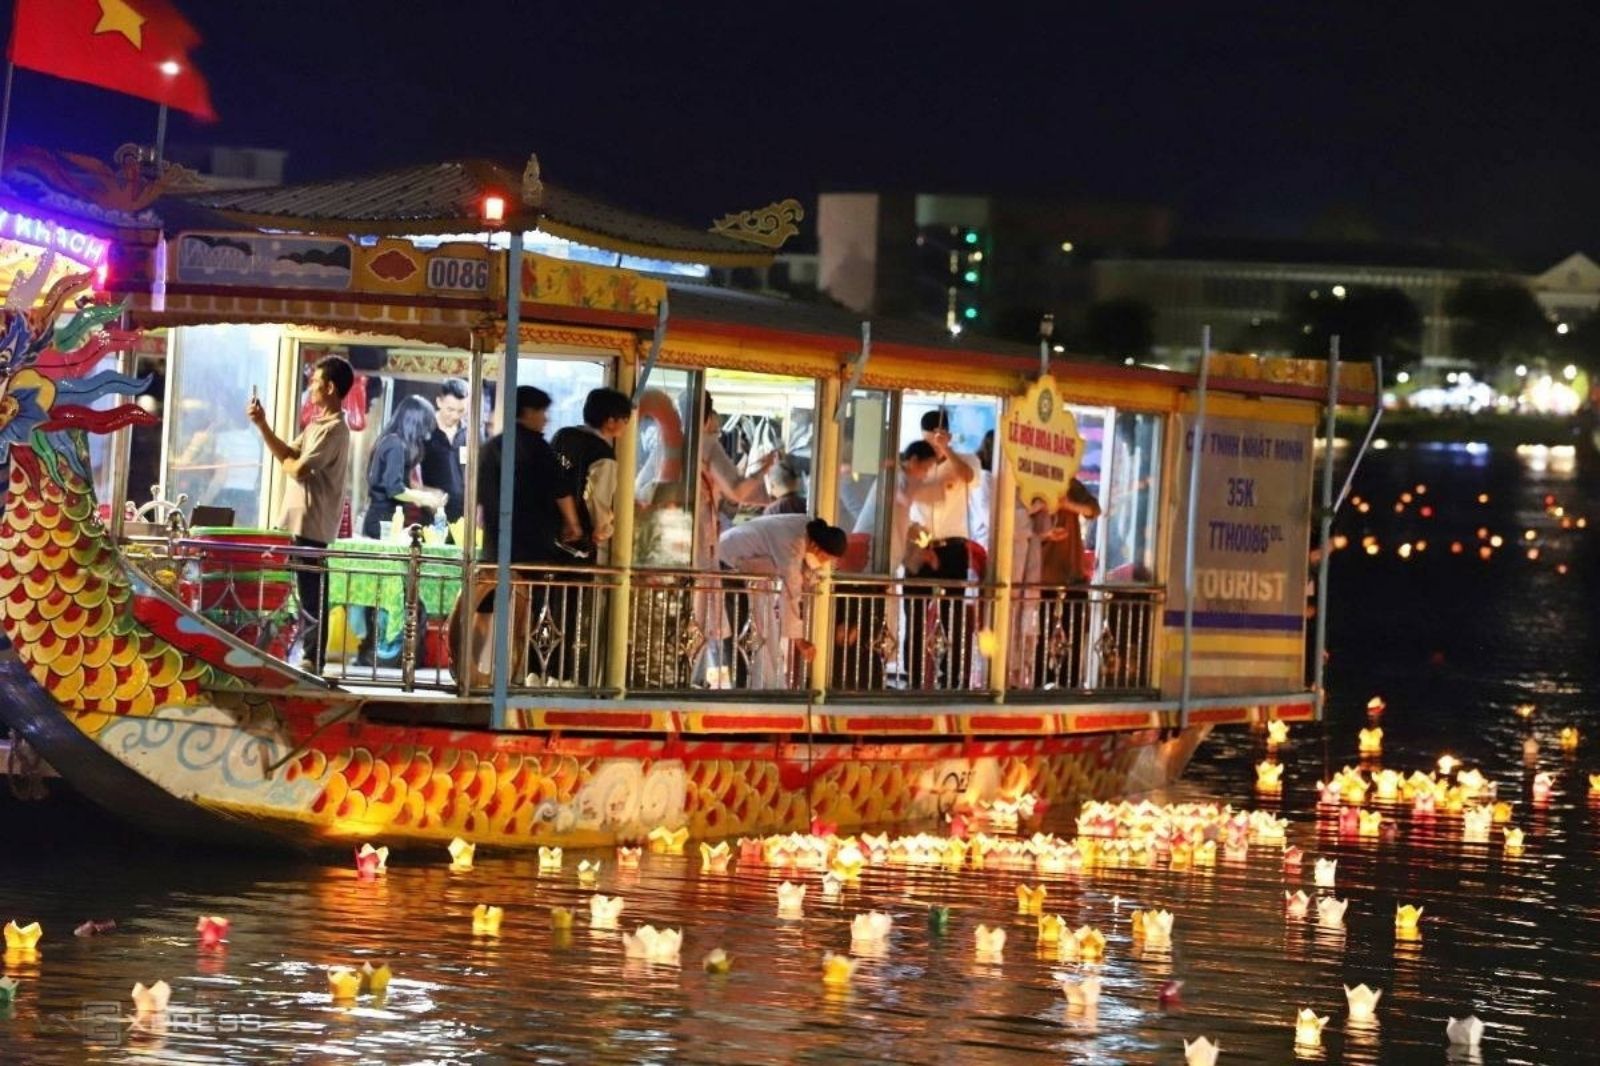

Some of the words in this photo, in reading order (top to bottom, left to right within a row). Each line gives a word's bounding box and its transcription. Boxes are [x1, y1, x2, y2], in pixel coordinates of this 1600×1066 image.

[432, 259, 488, 289] 0086
[1210, 433, 1240, 457] TNHH
[1274, 438, 1304, 464] MINH
[1227, 478, 1256, 508] 35K
[1193, 568, 1288, 602] TOURIST
